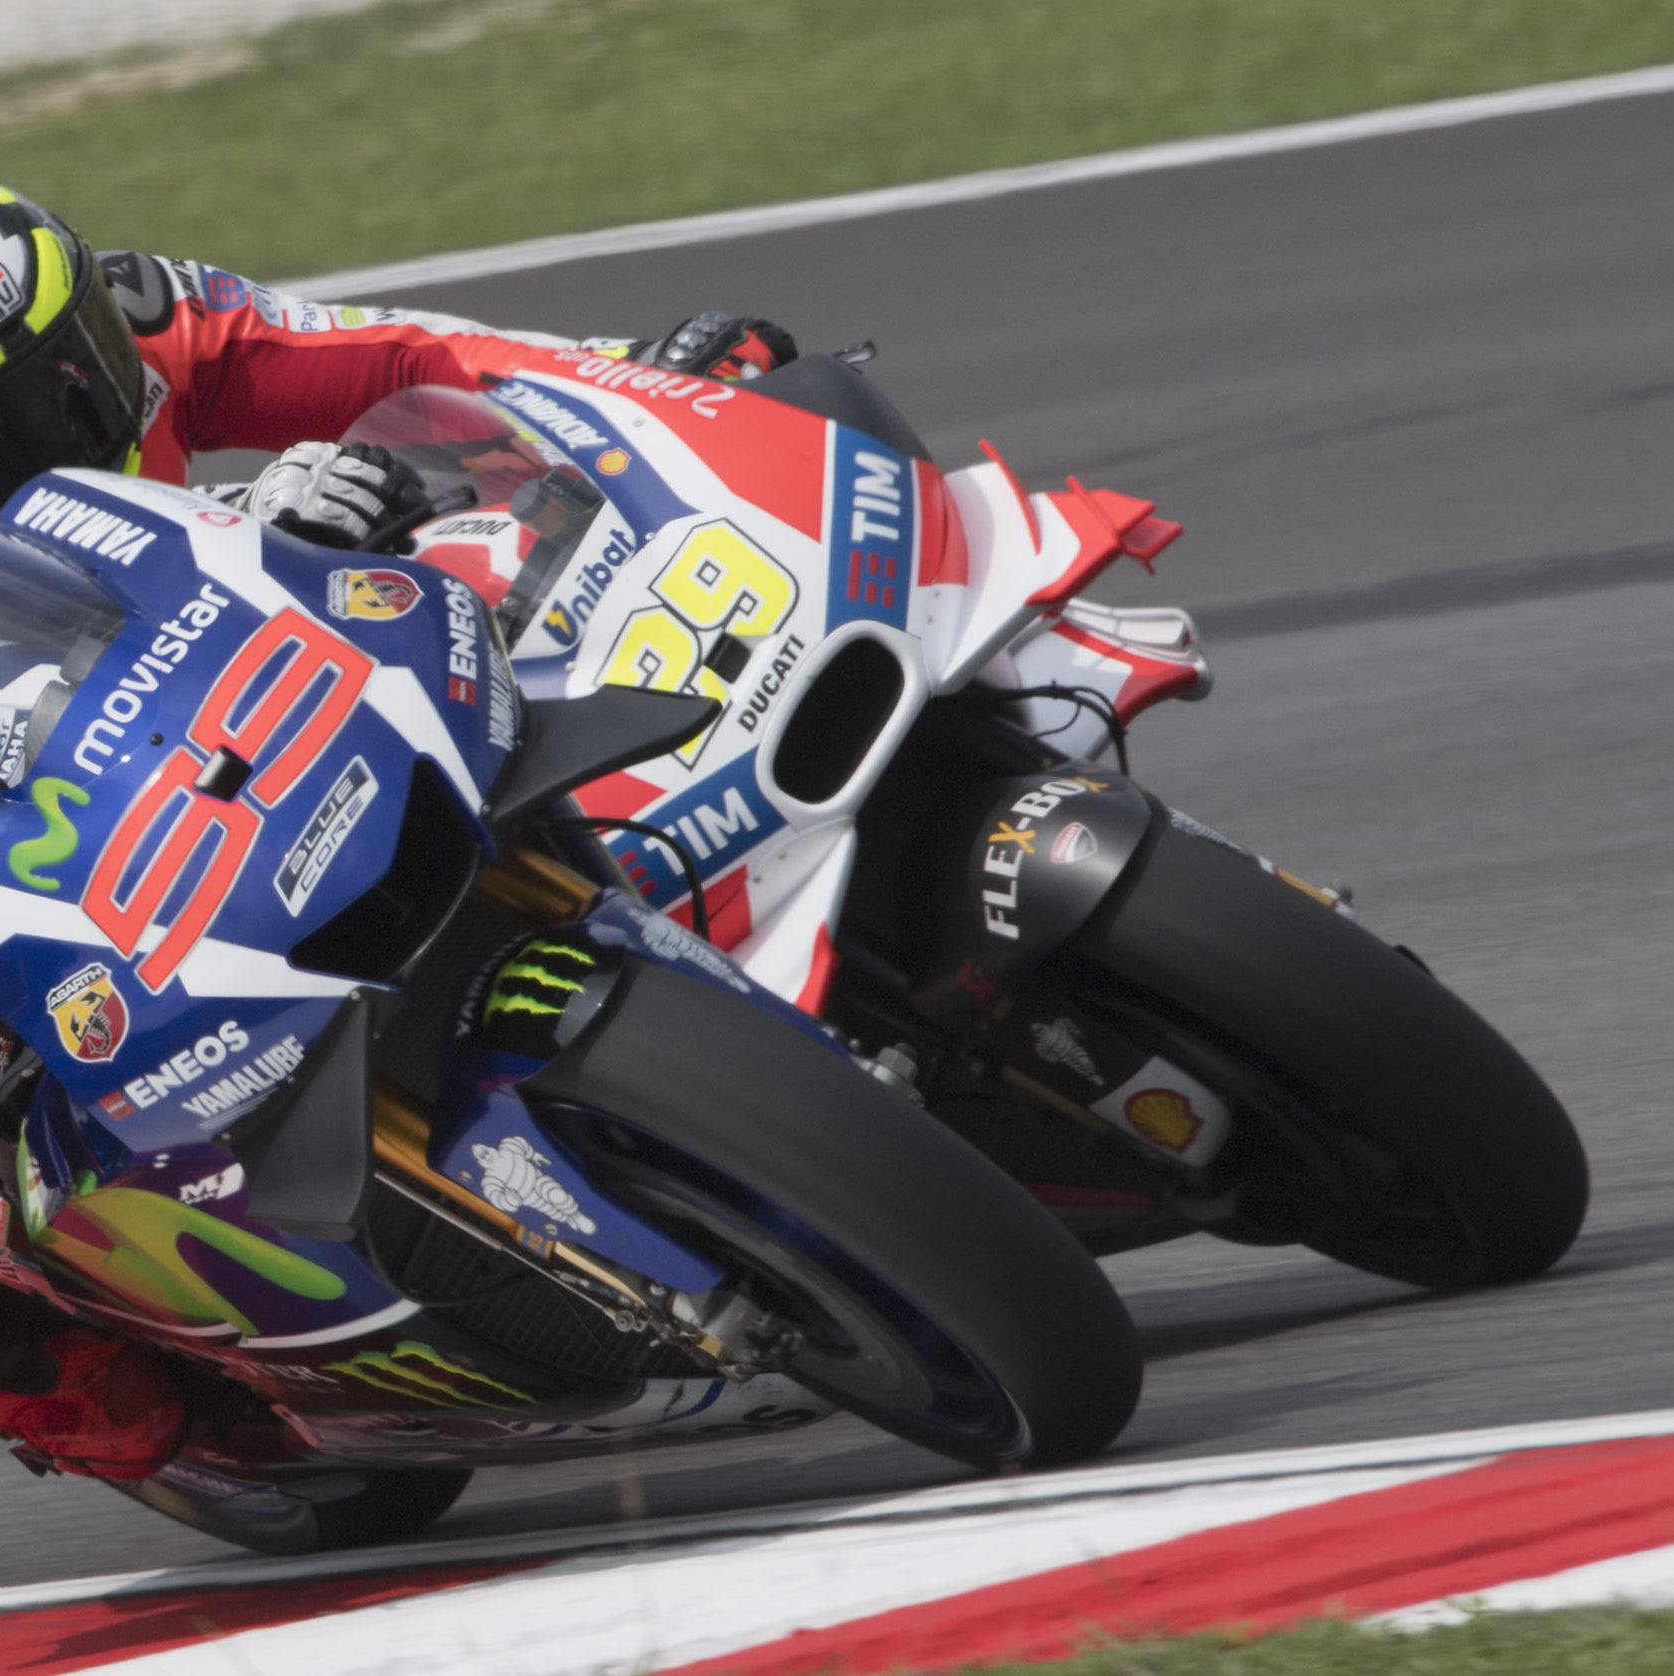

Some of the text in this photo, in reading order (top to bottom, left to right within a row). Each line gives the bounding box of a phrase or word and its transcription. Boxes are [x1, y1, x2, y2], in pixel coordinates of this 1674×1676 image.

[576, 355, 703, 400] riello
[13, 487, 158, 567] YAMAHA
[432, 519, 513, 537] DUCATI
[850, 451, 901, 543] TIM
[441, 578, 478, 681] ENEOS
[542, 528, 638, 647] Unibat
[74, 583, 231, 776] movistar
[593, 517, 800, 773] 29
[736, 633, 806, 733] DUCATI
[82, 606, 380, 996] 99
[287, 777, 355, 866] BLUE
[300, 795, 365, 893] CORE
[642, 786, 760, 876] TIM
[982, 776, 1110, 941] FLEX-BOX
[50, 966, 103, 1007] ABARTH
[124, 1020, 251, 1109] ENEOS
